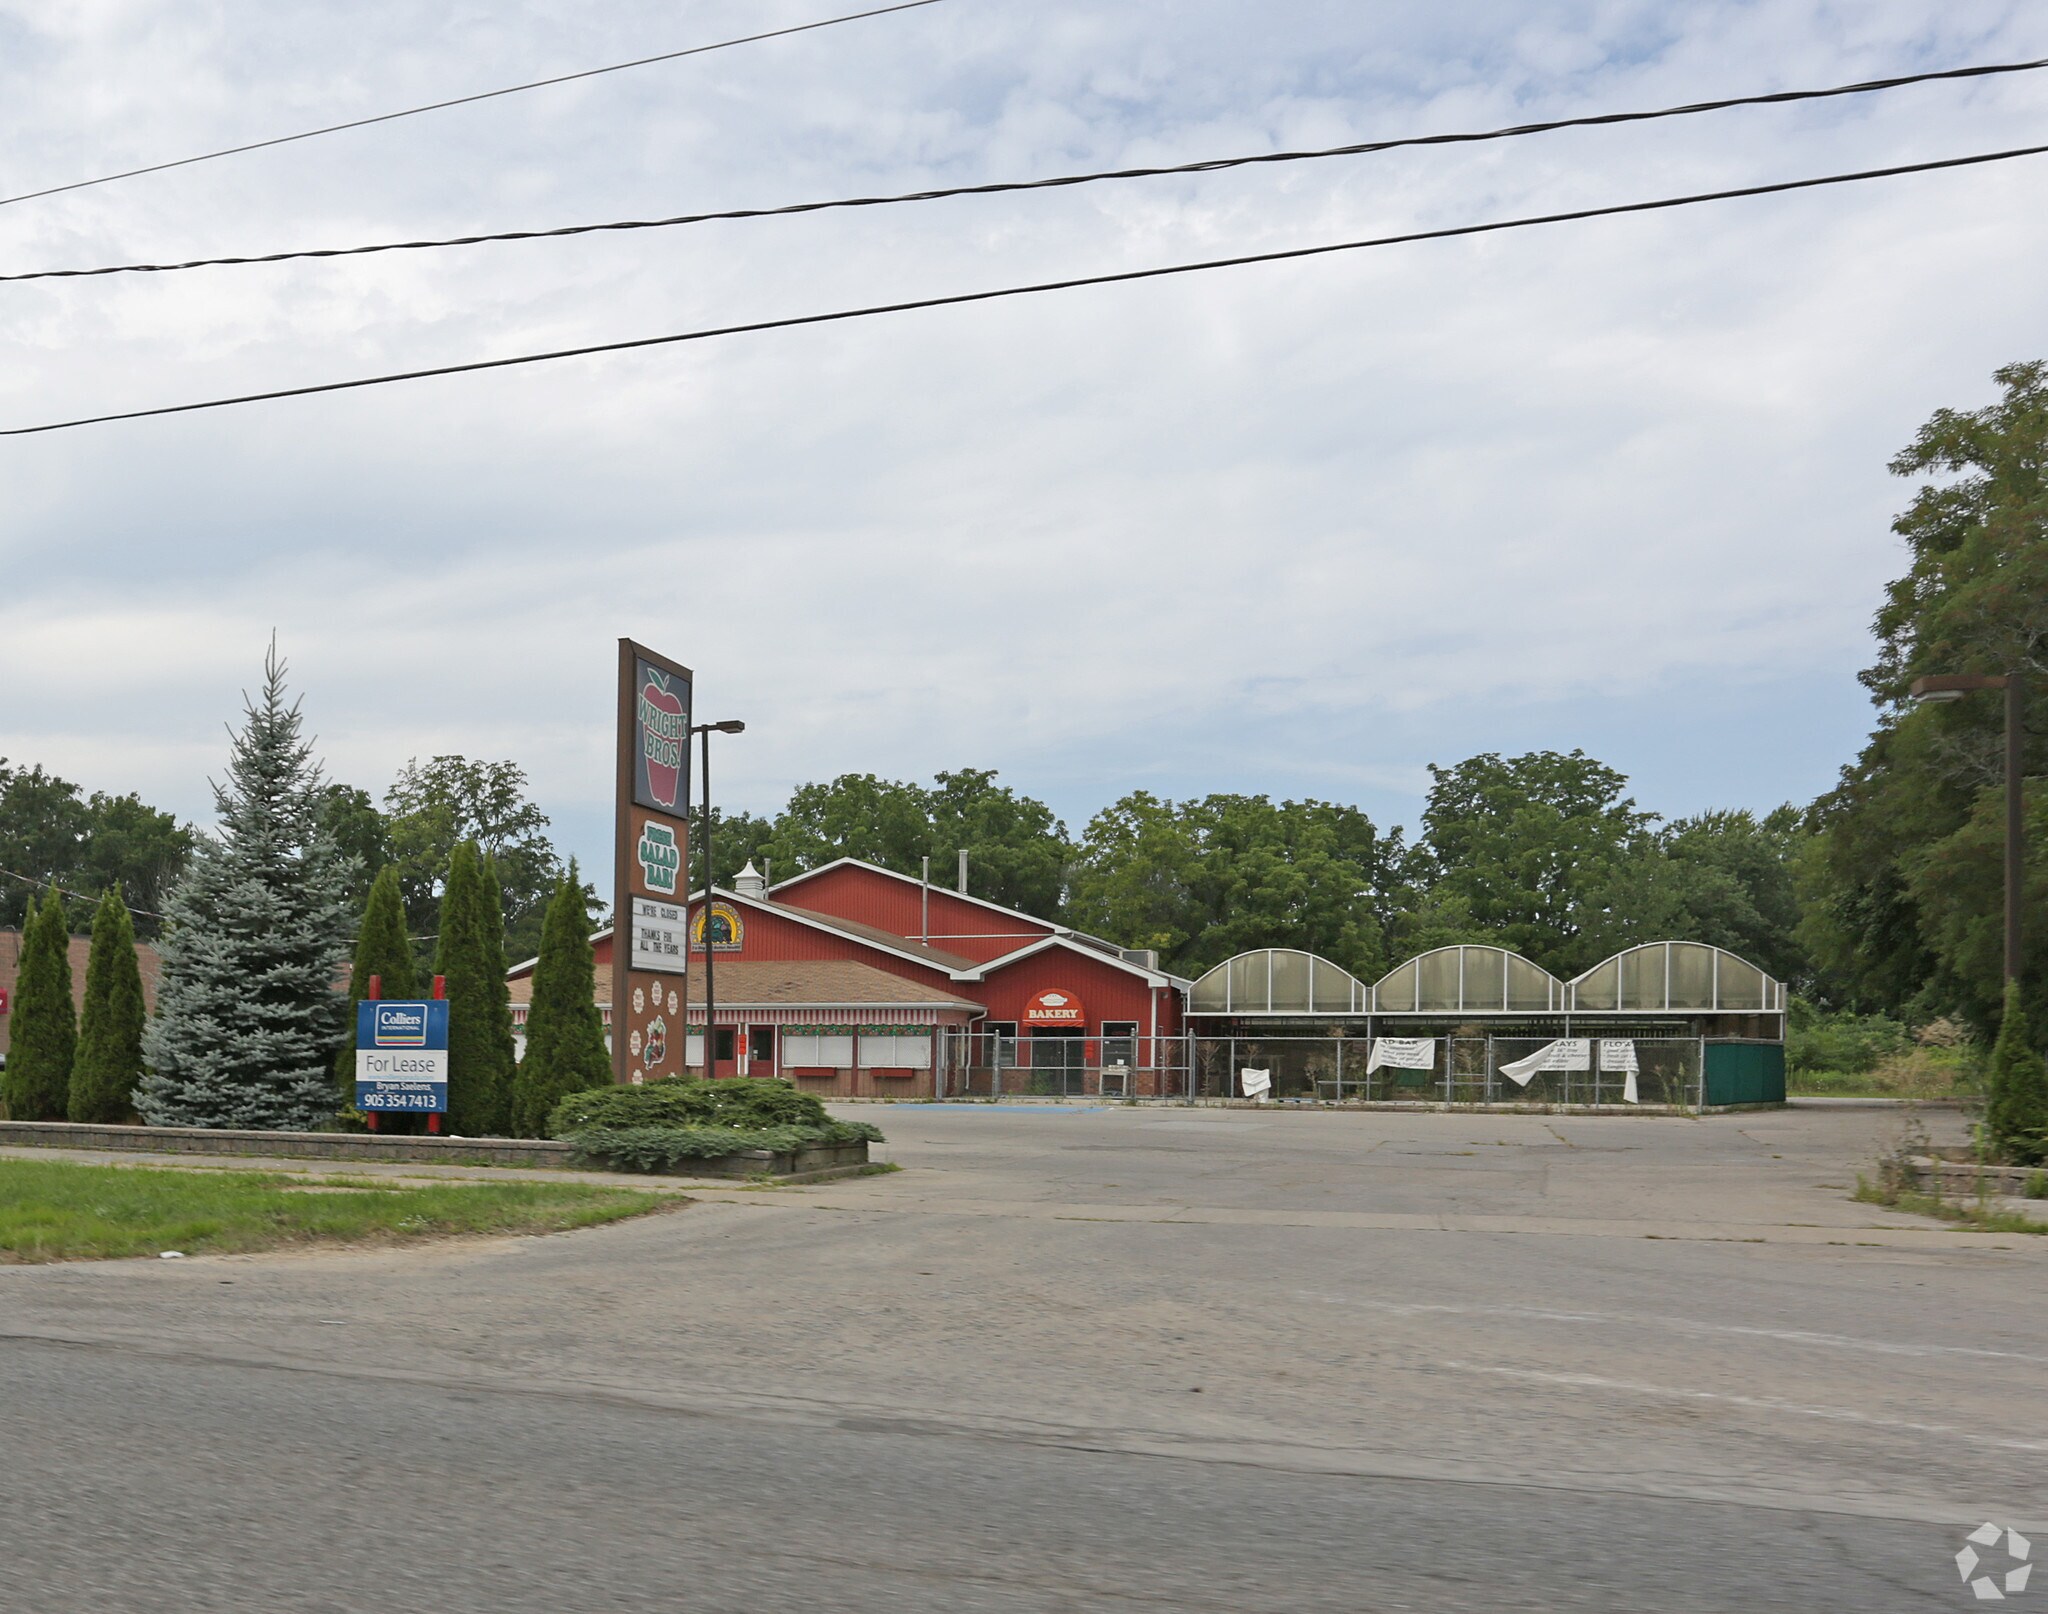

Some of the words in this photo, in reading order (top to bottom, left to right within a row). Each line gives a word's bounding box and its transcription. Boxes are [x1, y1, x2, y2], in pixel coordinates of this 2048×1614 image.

[638, 692, 687, 739] WRIGHT
[640, 841, 678, 869] SALAD
[646, 864, 673, 889] BAR!
[661, 908, 679, 920] CLOSED
[641, 928, 660, 941] THANKS
[663, 931, 672, 943] FOR
[640, 940, 649, 951] ALL
[653, 942, 662, 953] THE
[664, 943, 679, 955] YEARS
[380, 1012, 421, 1025] Colliers
[1028, 1009, 1078, 1019] BAKERY
[366, 1055, 389, 1072] For
[393, 1055, 435, 1073] Lease
[376, 1081, 400, 1093] Bryan
[364, 1094, 385, 1107] 905
[385, 1094, 407, 1108] 354
[408, 1095, 437, 1108] 7413
